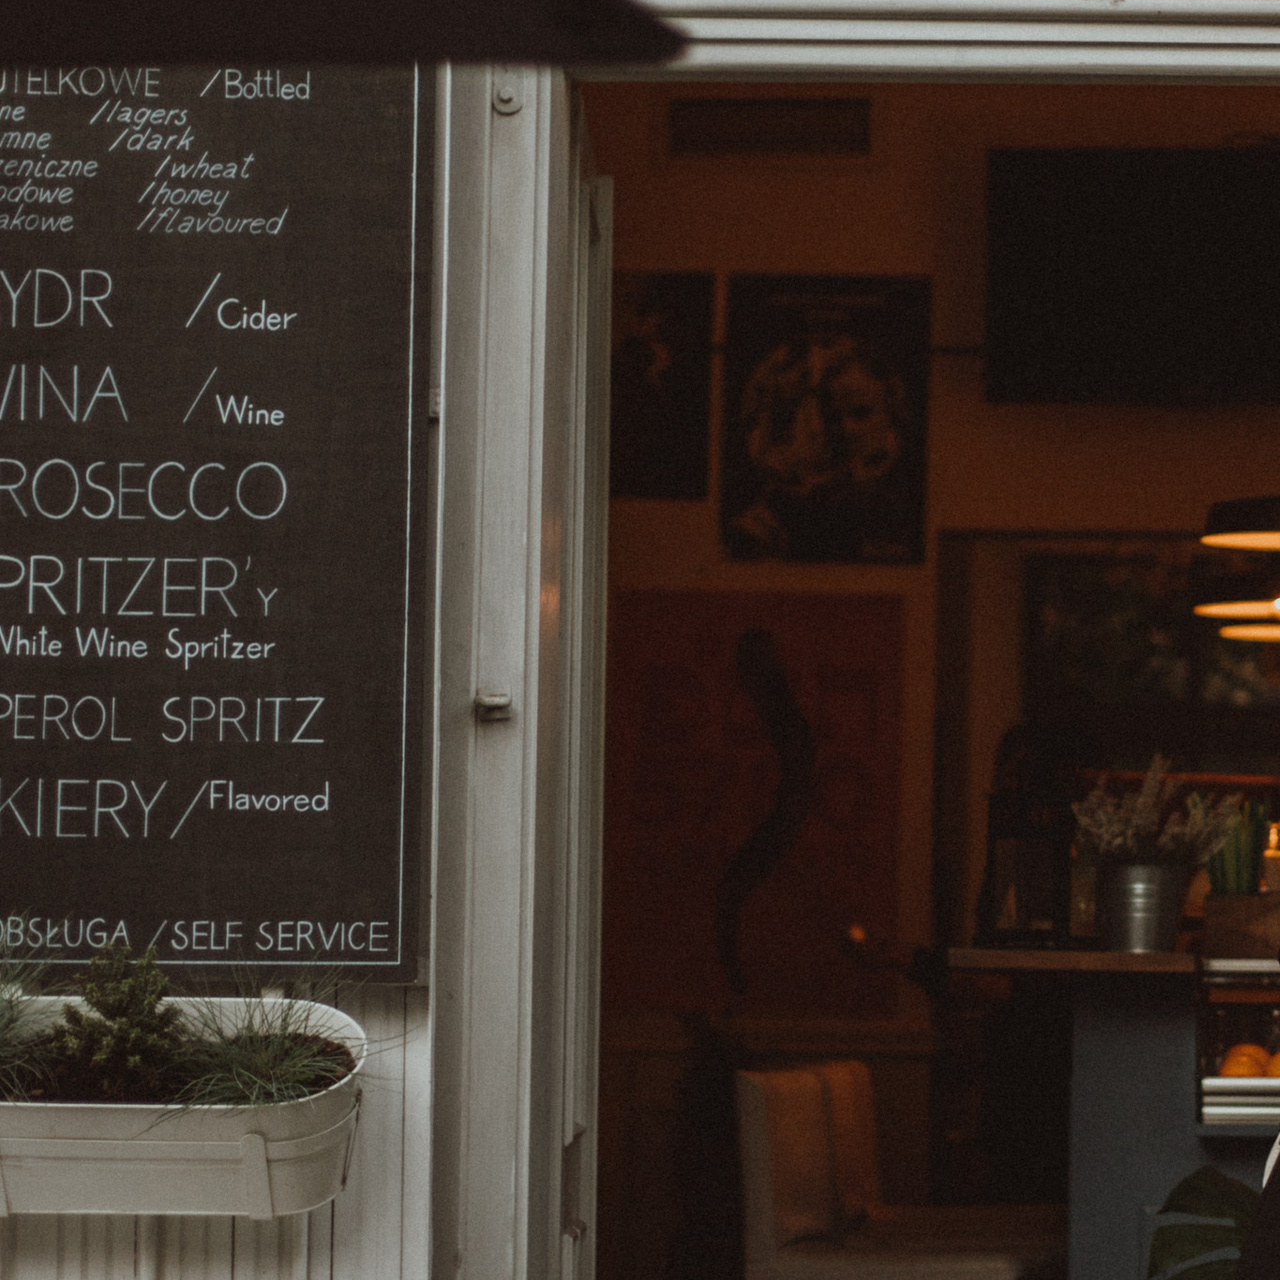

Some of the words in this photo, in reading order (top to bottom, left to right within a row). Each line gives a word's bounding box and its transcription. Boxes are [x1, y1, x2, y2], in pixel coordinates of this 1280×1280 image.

[0, 267, 114, 329] YDR
[0, 363, 129, 423] INA
[74, 626, 149, 659] Wine
[163, 626, 277, 671] Spritzer
[161, 695, 326, 744] SPRITZ
[255, 921, 390, 952] SERVICE
